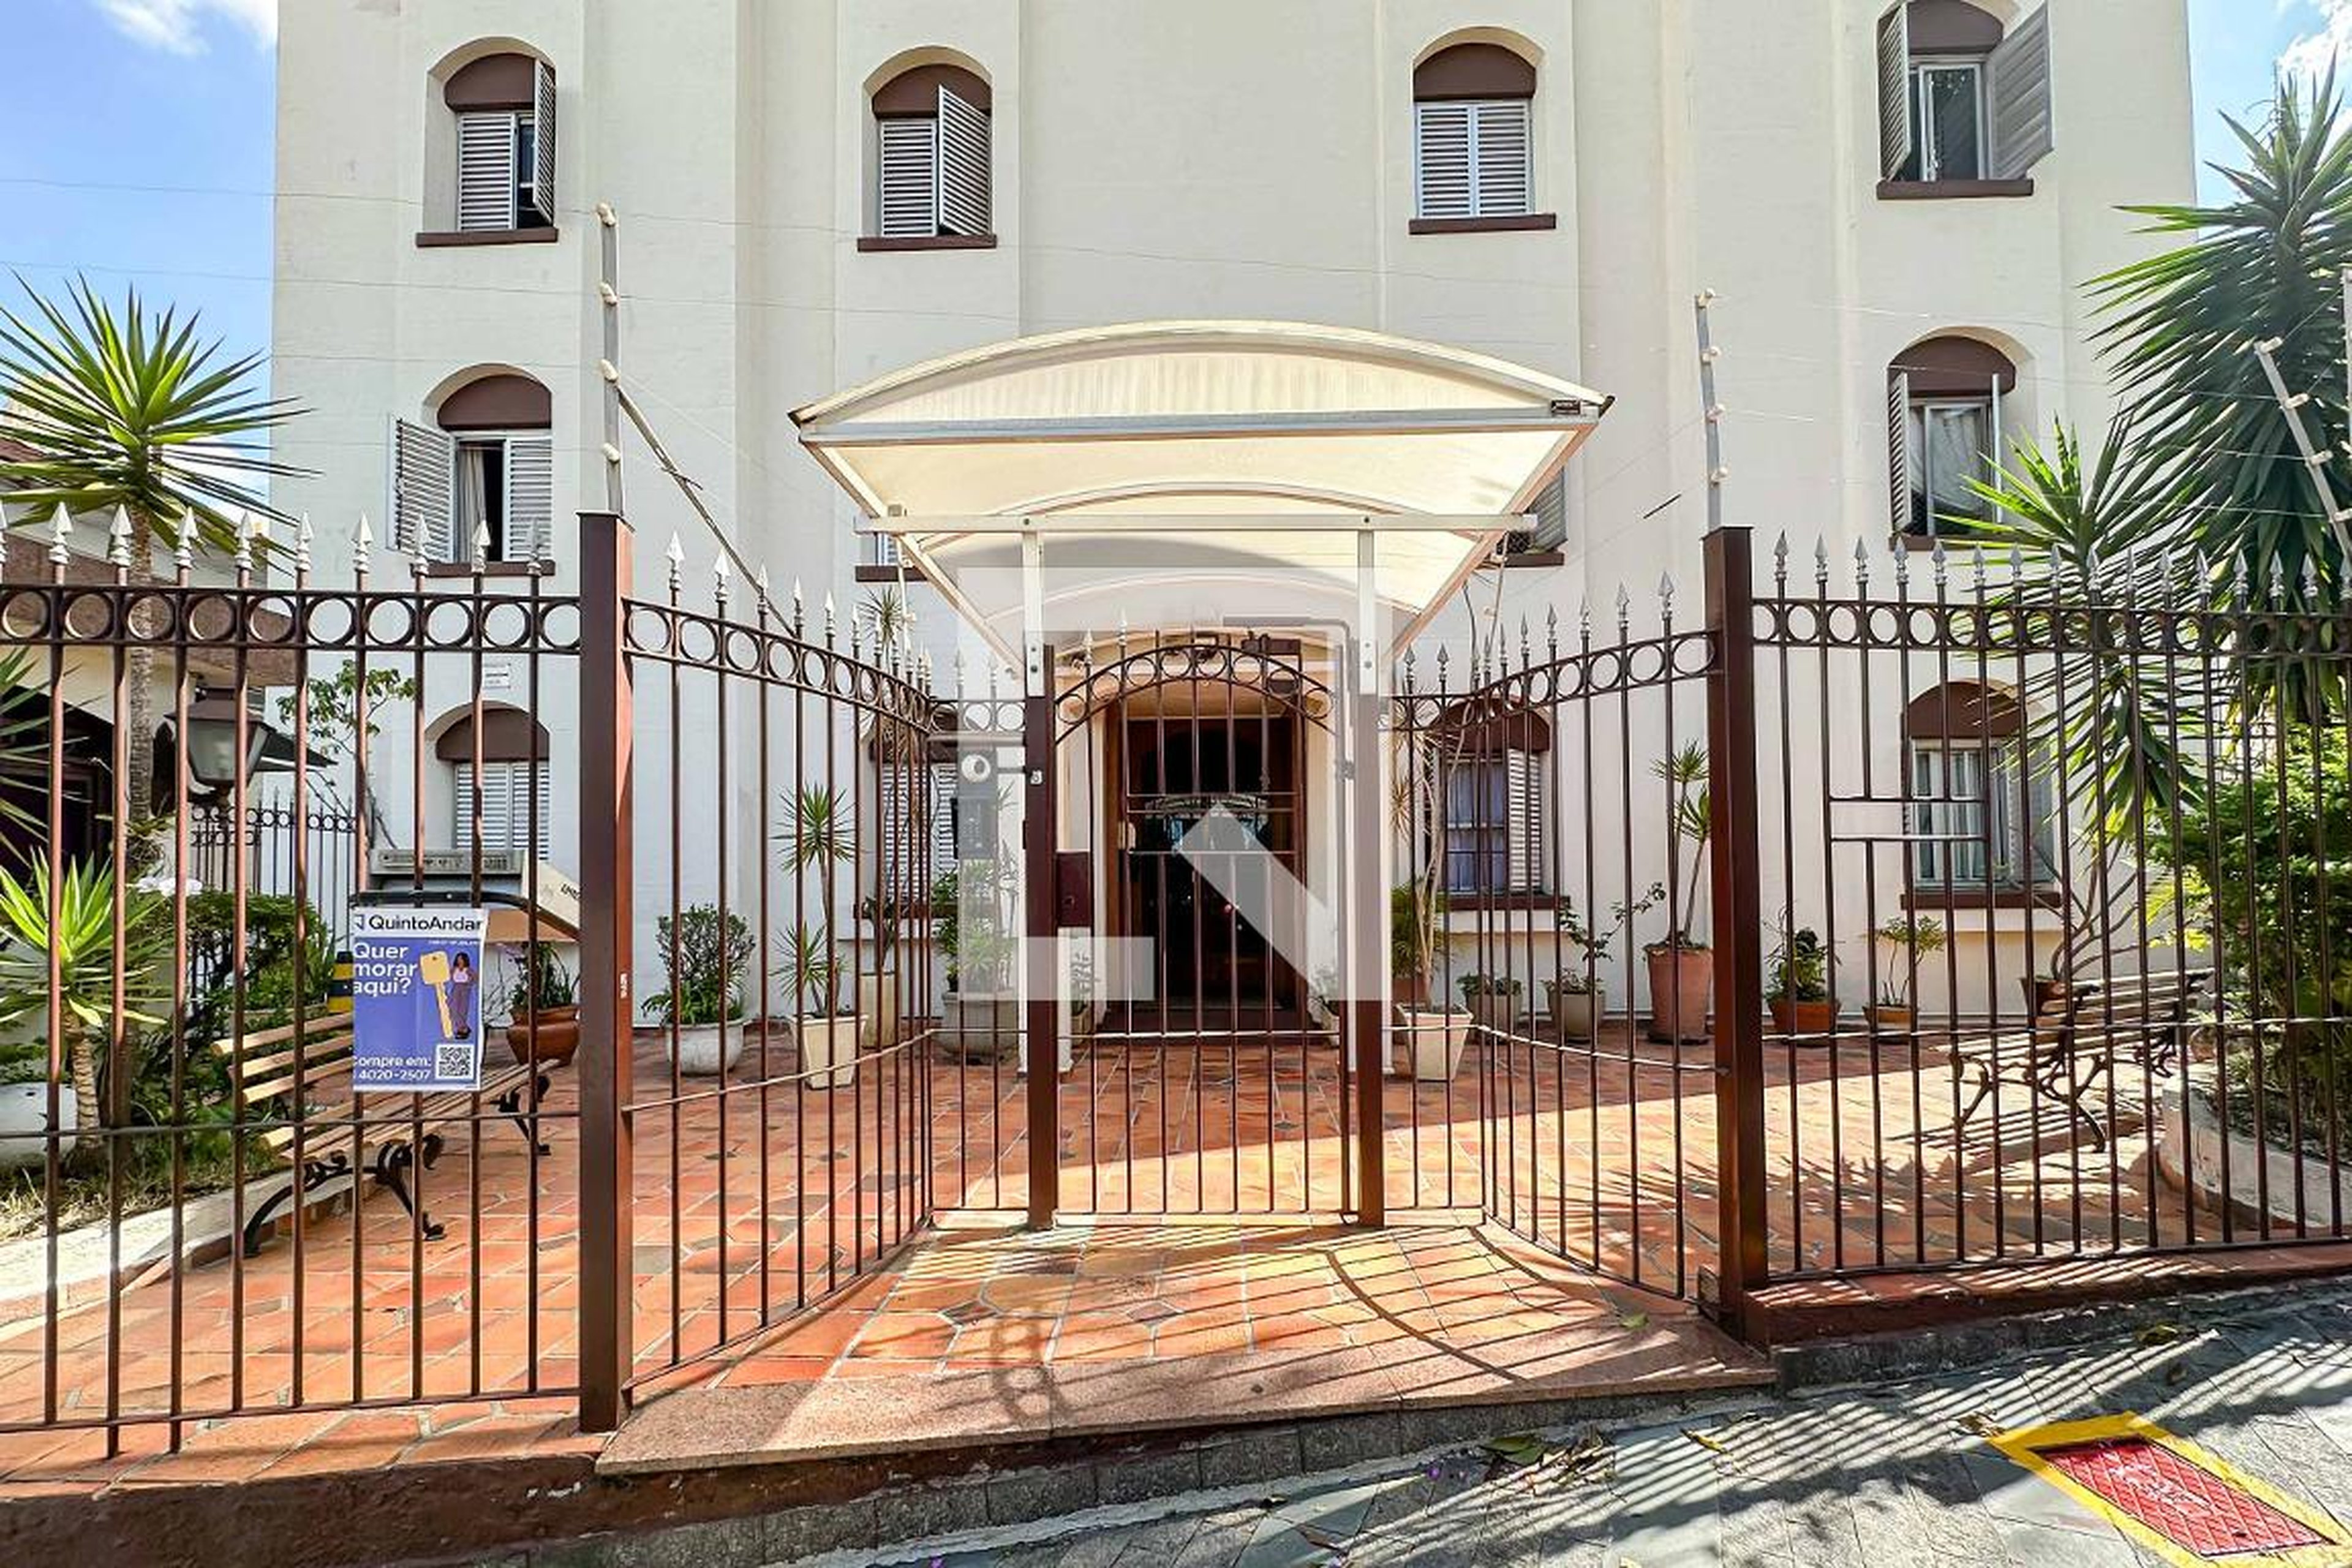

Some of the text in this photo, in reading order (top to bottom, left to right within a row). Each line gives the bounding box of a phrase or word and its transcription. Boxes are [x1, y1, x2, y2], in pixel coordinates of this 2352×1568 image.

[369, 915, 482, 930] QuintoAndar
[354, 942, 409, 959] Quer
[354, 963, 418, 977] morar
[353, 978, 412, 997] aqui?
